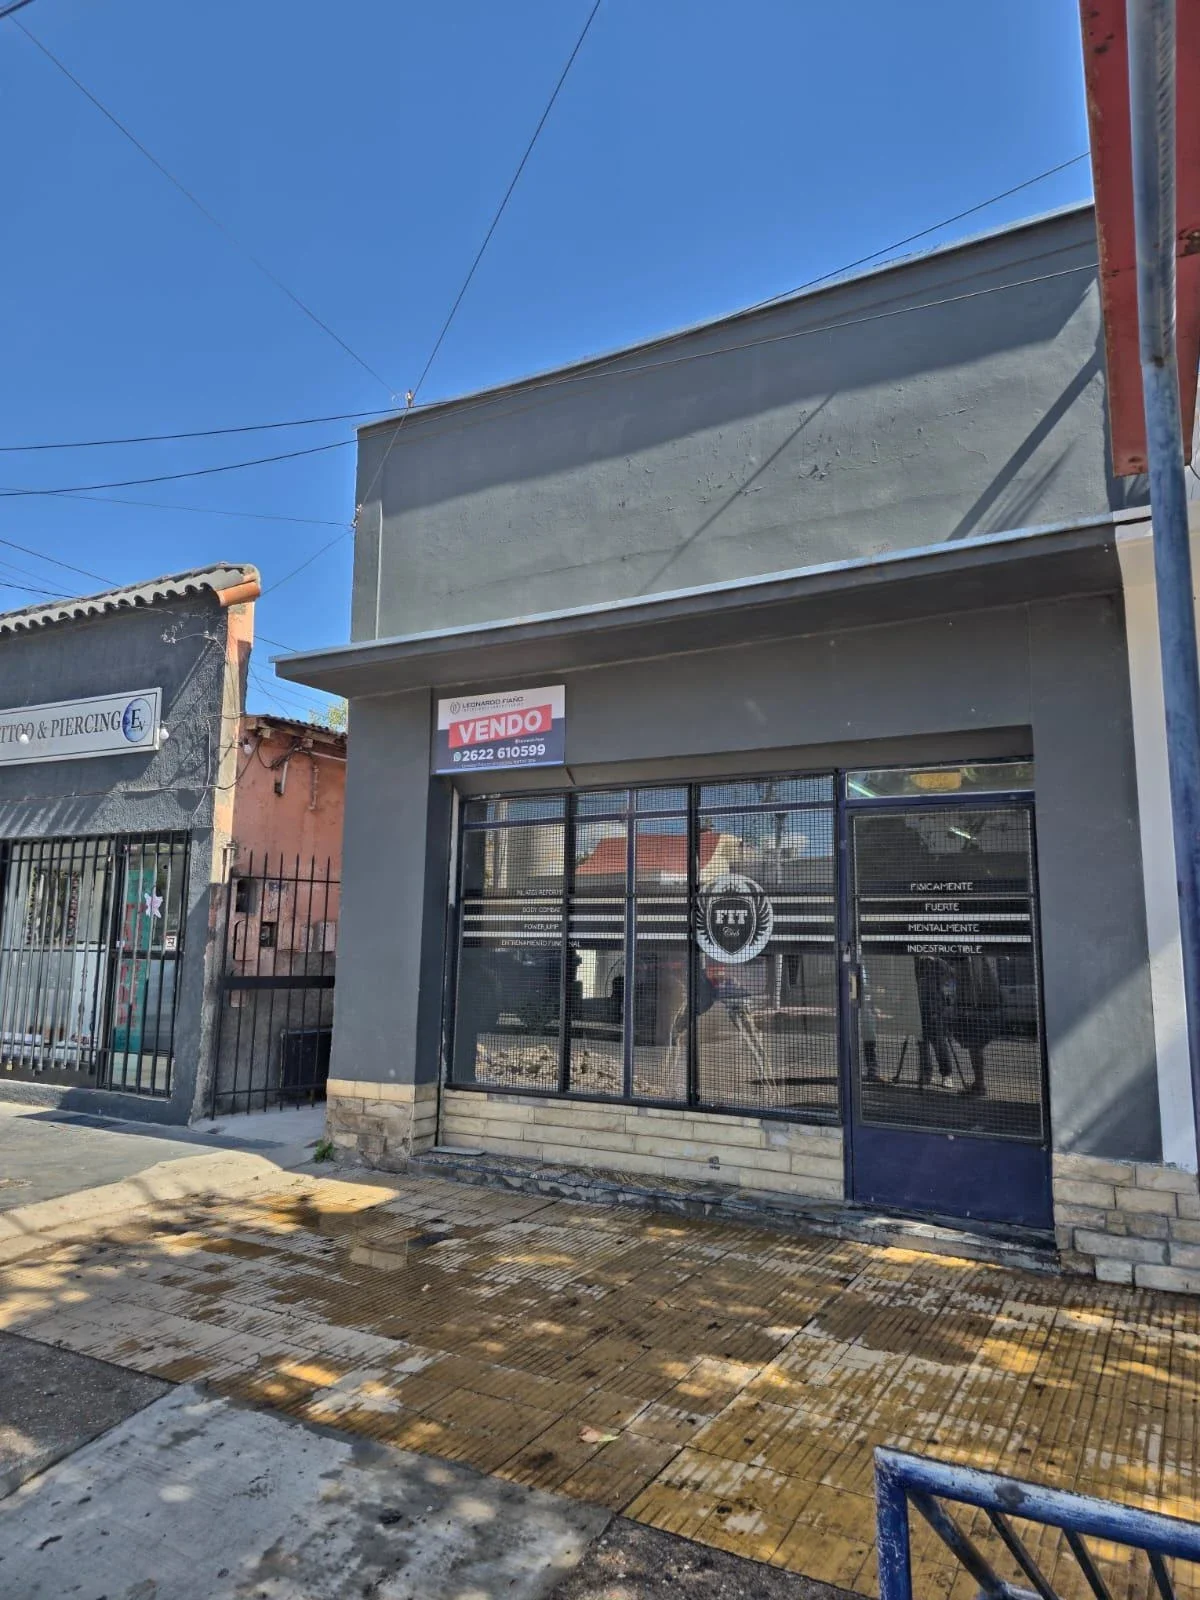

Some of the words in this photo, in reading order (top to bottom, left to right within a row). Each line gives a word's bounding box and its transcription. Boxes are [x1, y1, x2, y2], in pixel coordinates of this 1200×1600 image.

[462, 699, 500, 709] LEONARDO
[37, 720, 48, 740] &
[50, 710, 121, 738] PIERCING
[458, 710, 543, 744] VENDO
[462, 749, 494, 762] 2622
[497, 743, 546, 759] 610599
[910, 882, 974, 891] FISICAMENTE
[925, 902, 960, 912] FUERTE
[714, 909, 748, 925] FIT
[908, 923, 980, 933] MENTALMENTE
[907, 944, 983, 954] INDESTRUCTIBLE
